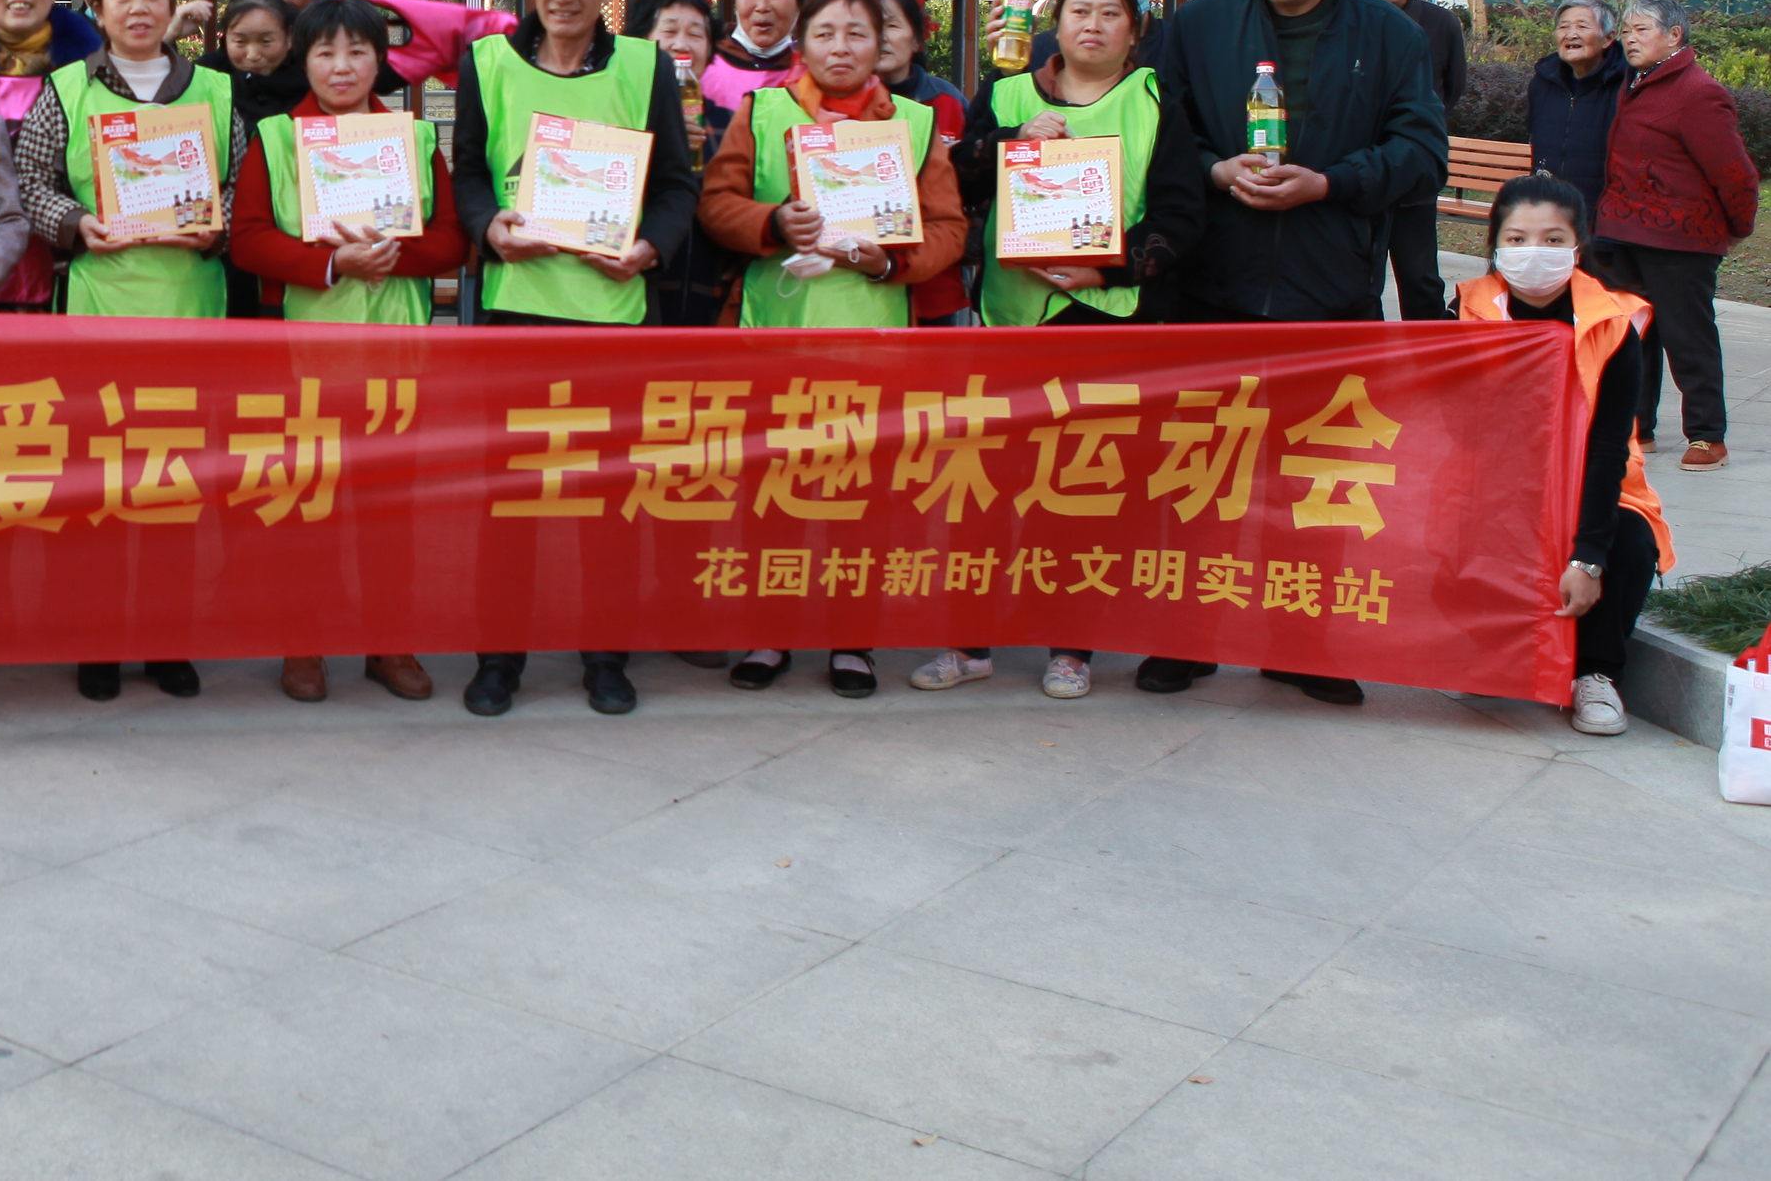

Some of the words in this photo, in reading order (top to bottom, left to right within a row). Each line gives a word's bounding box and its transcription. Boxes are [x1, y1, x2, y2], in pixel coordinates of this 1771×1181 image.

[693, 546, 1393, 625] 花园村新时代文明实践站
